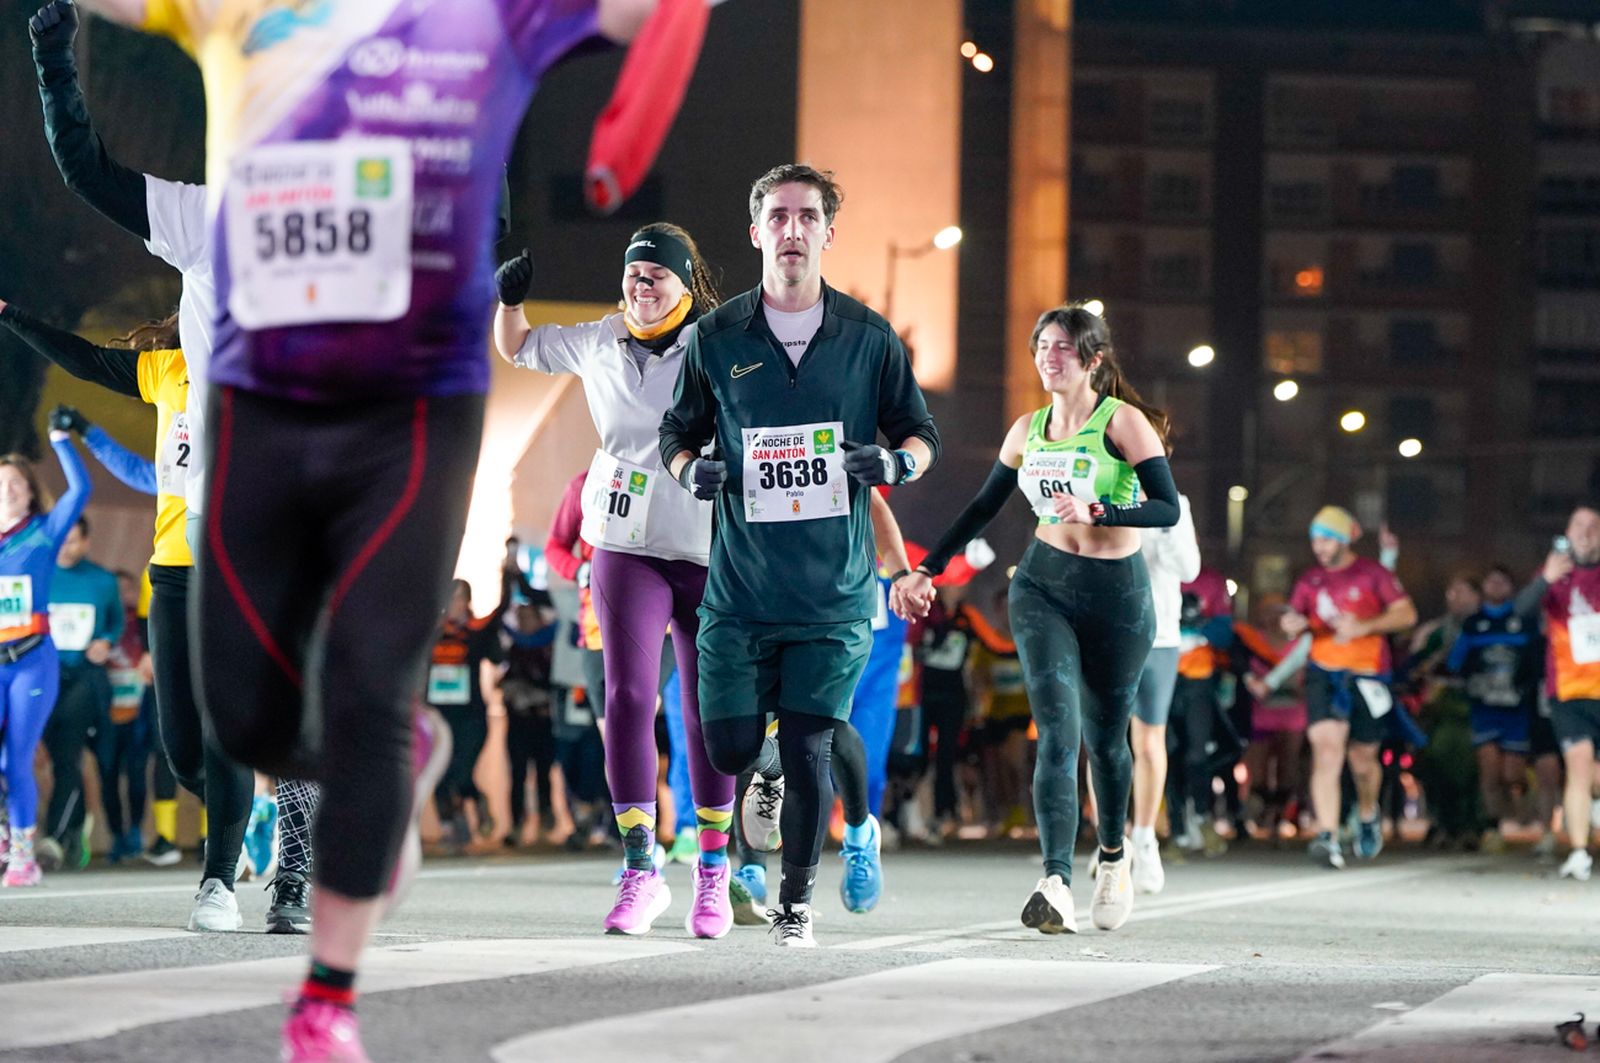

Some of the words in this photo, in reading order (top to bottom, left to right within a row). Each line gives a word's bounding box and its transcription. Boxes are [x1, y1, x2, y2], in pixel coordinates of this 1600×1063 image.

[255, 208, 371, 261] 5858
[782, 340, 807, 348] ipsta
[762, 437, 791, 447] NOCHE
[794, 436, 804, 445] DE
[752, 449, 770, 460] SAN
[1036, 460, 1057, 468] NOCHE
[1058, 461, 1067, 469] DE
[759, 458, 828, 490] 3638
[786, 490, 804, 498] Pablo
[1039, 478, 1076, 499] 601
